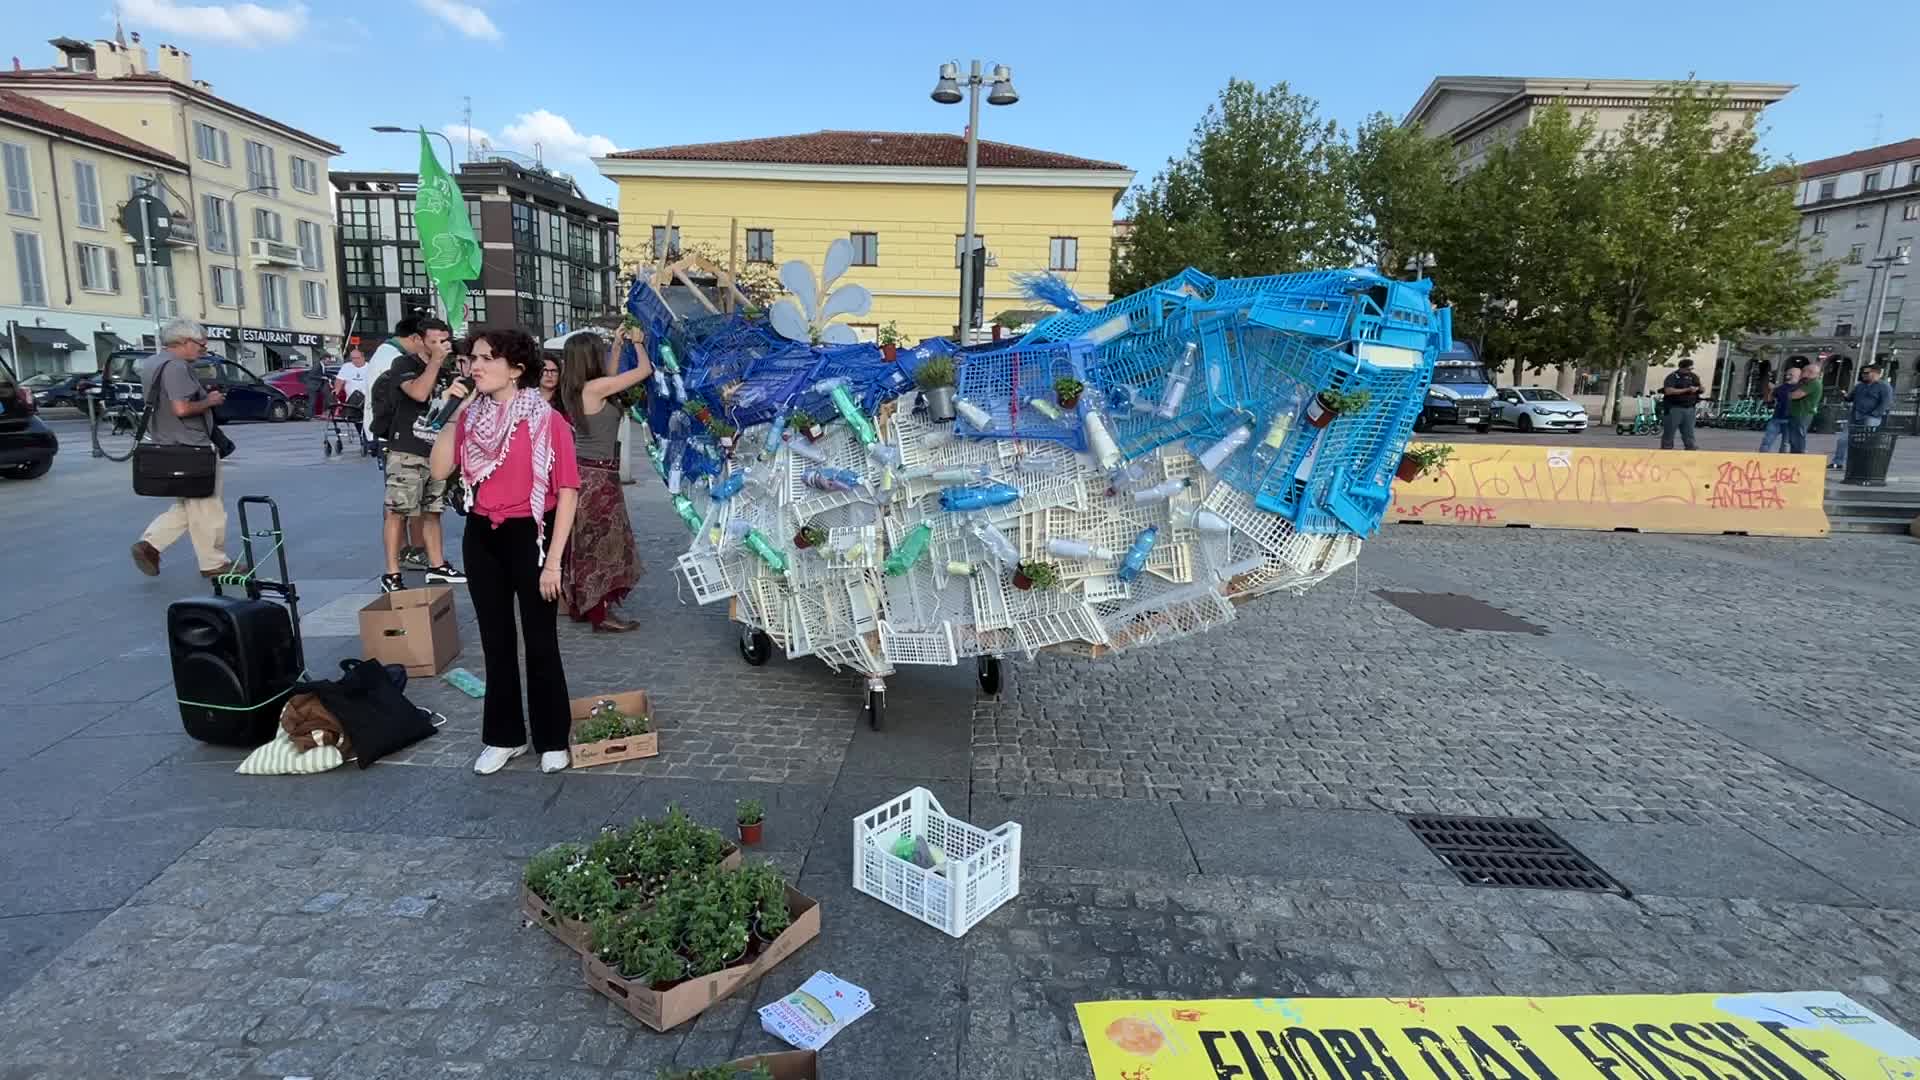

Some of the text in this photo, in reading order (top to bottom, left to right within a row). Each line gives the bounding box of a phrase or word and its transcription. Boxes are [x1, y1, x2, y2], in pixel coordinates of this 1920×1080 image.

[400, 287, 424, 295] HOTEL
[207, 326, 318, 345] KFC ESTAURANT KFC
